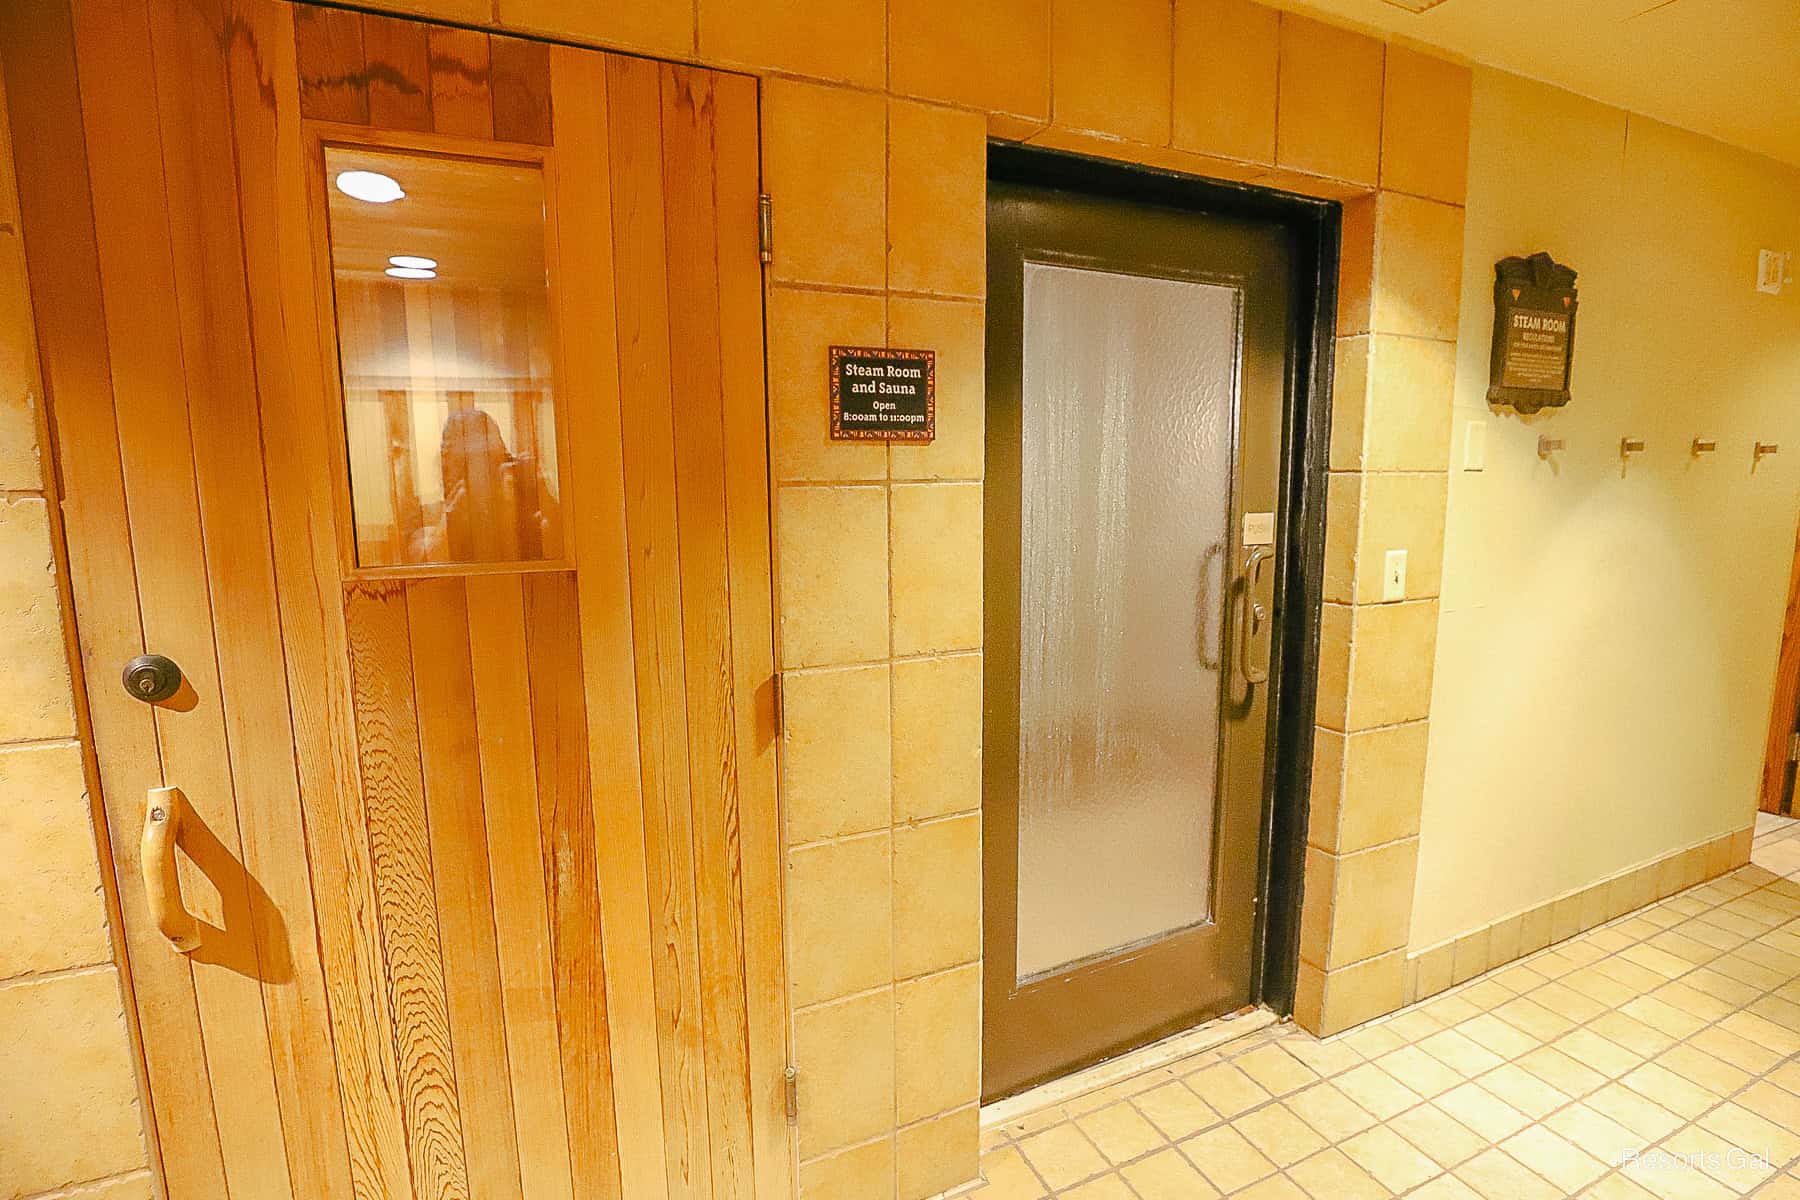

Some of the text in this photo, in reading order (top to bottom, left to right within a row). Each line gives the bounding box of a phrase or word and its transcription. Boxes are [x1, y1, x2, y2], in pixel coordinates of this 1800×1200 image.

[1513, 315, 1567, 332] STEAM ROOM
[845, 364, 921, 378] Steam Room
[852, 380, 916, 395] and Sauna
[872, 401, 896, 411] Open
[843, 412, 924, 424] 8:00am to 11:00pm
